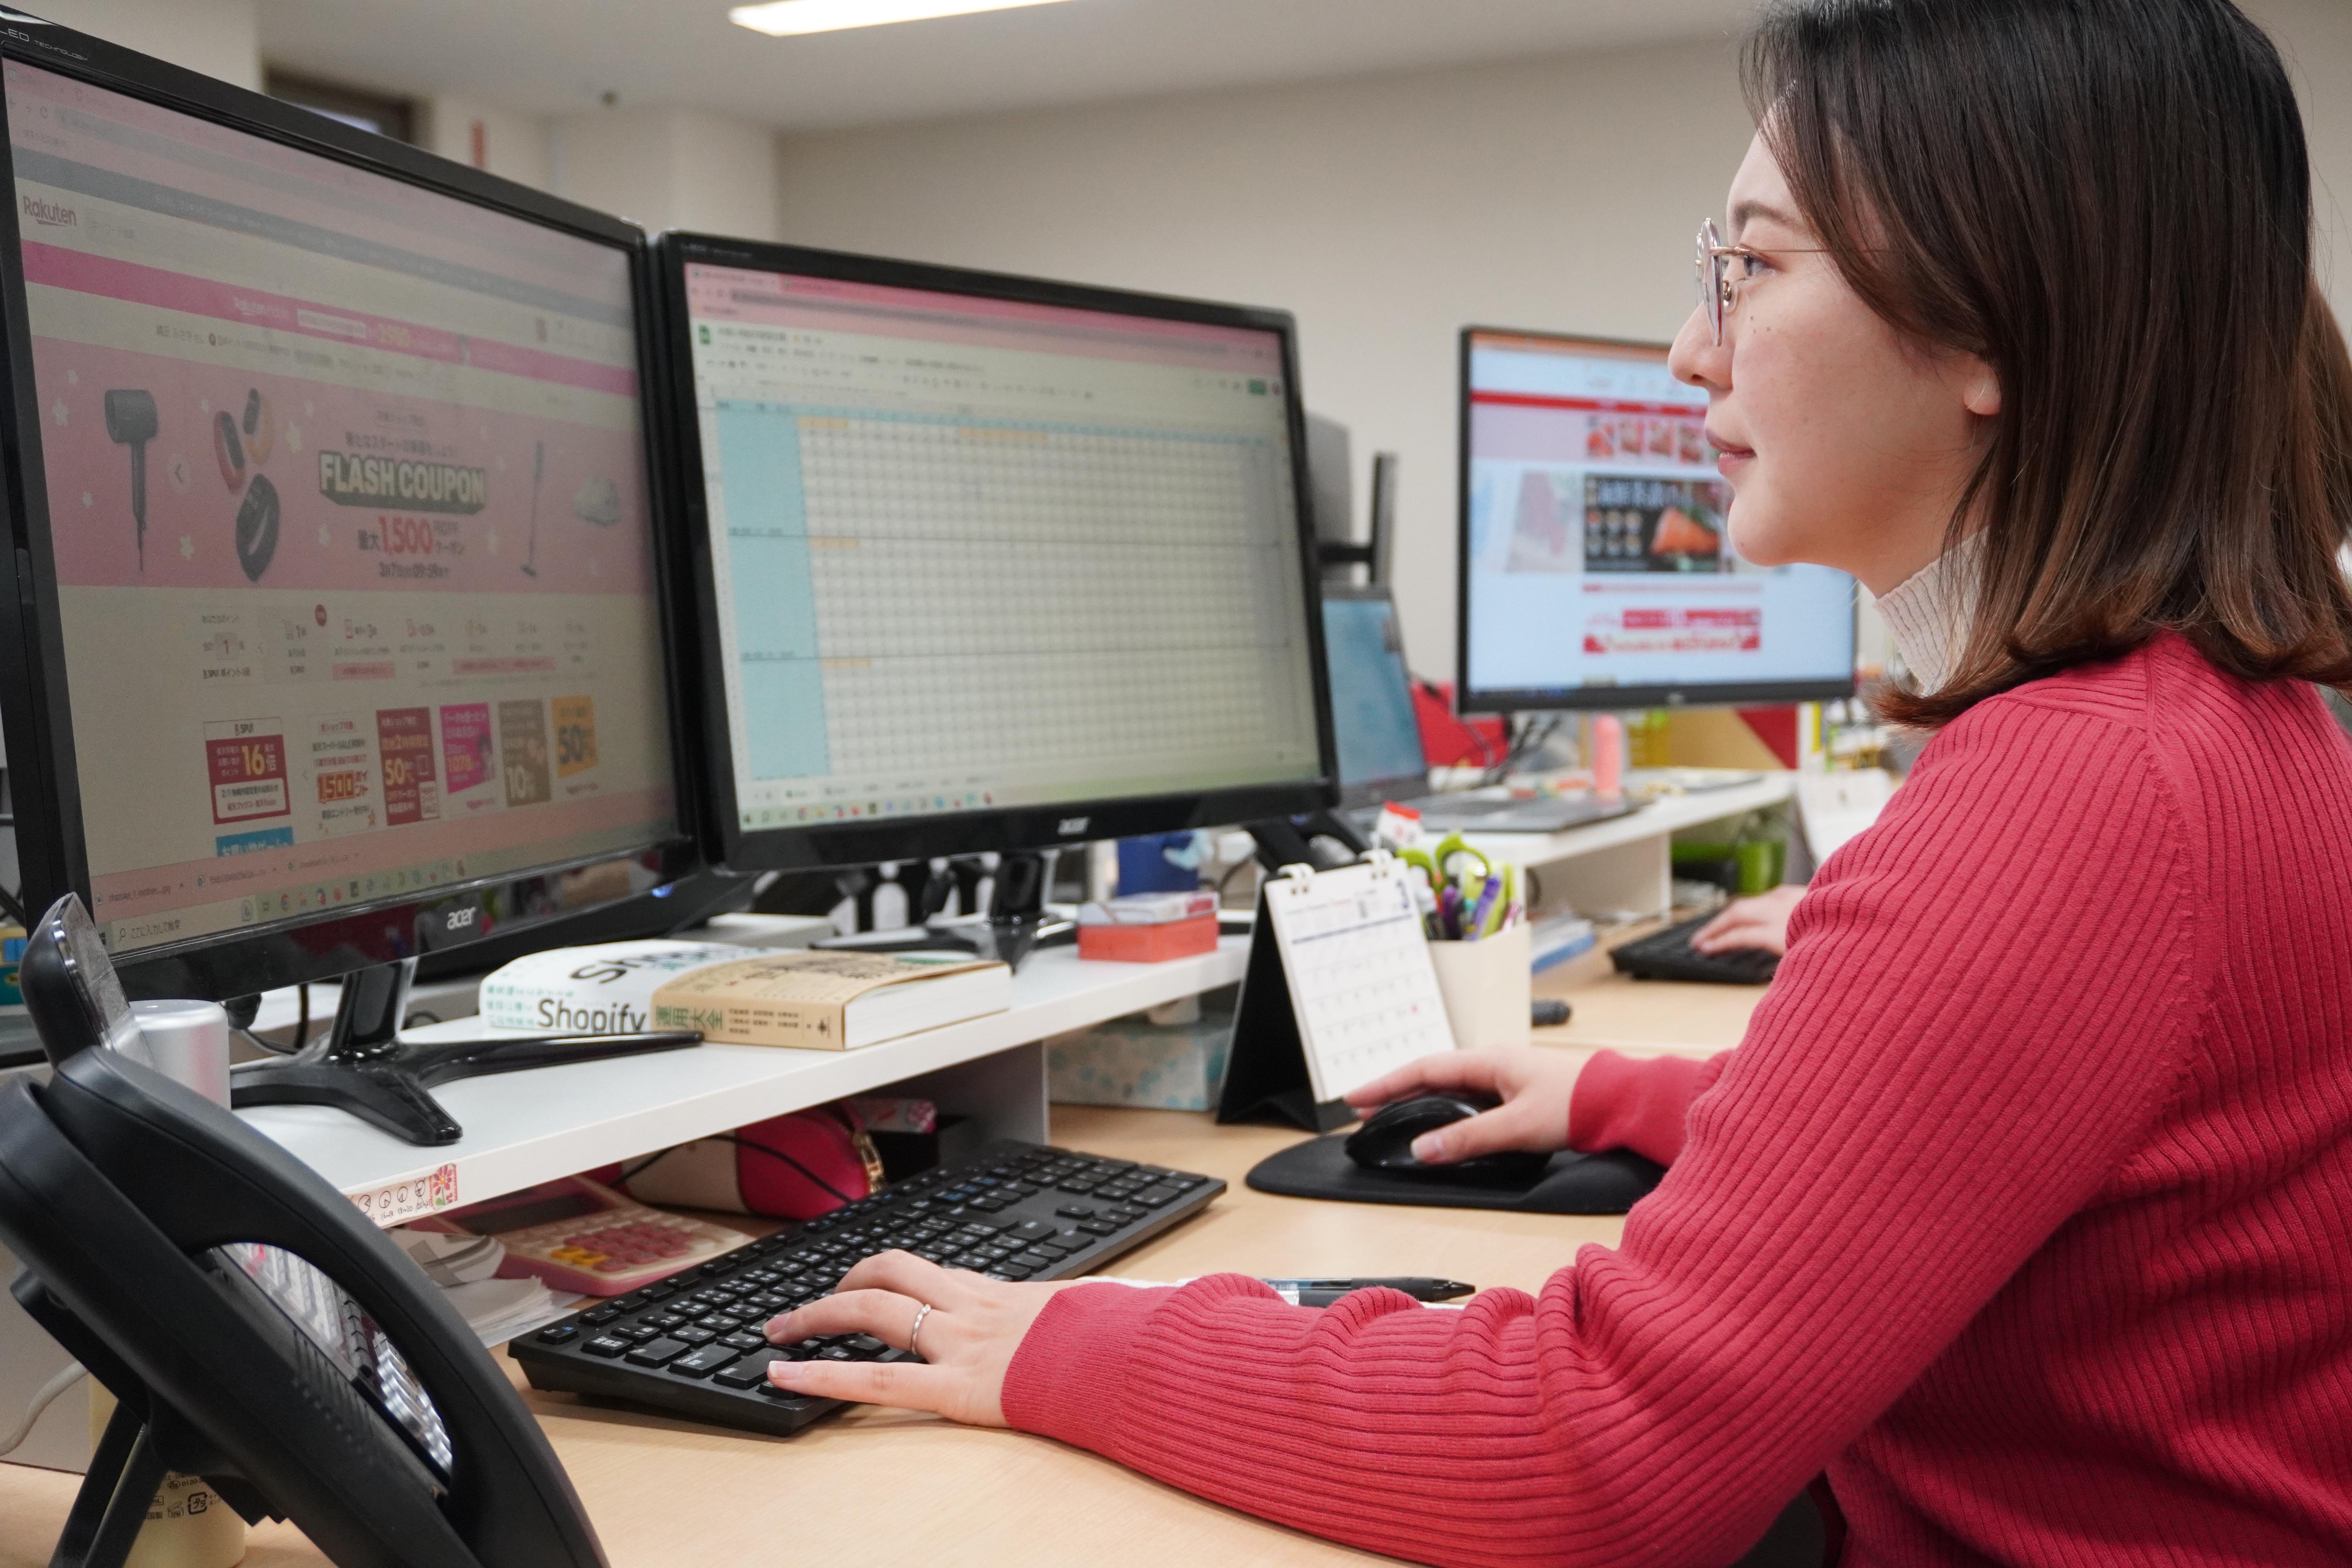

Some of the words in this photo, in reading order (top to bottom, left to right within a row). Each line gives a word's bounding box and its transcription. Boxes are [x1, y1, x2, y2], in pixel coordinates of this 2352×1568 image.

[23, 195, 77, 226] Rakuten
[319, 451, 395, 497] FLASH
[397, 462, 485, 506] COUPON
[378, 516, 434, 556] 1,500
[241, 744, 265, 776] 16
[447, 906, 477, 930] acer
[537, 998, 647, 1034] Shopify
[193, 1497, 207, 1509] プラ
